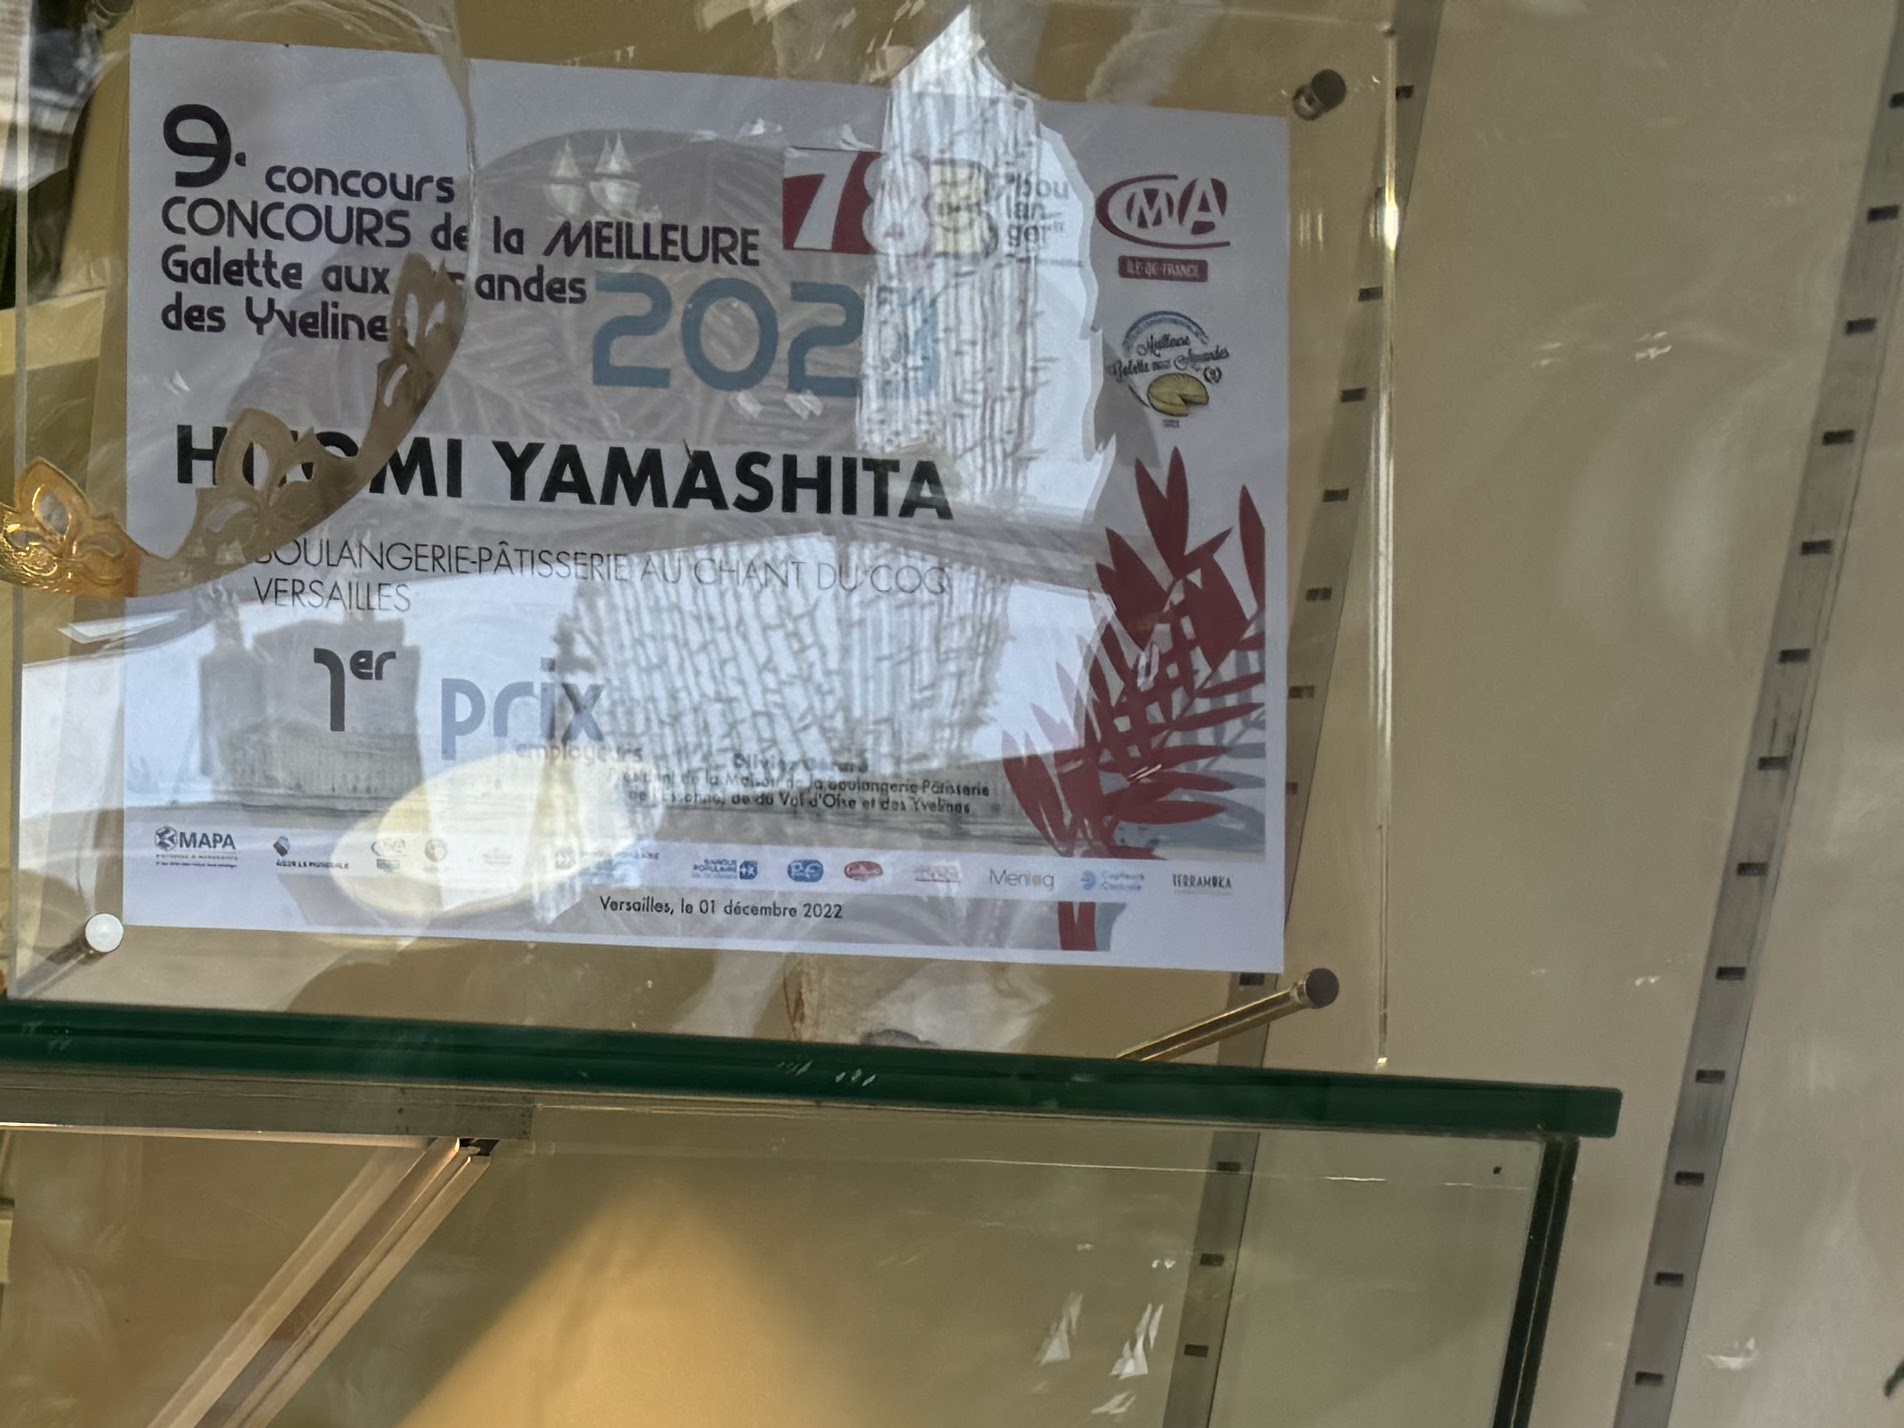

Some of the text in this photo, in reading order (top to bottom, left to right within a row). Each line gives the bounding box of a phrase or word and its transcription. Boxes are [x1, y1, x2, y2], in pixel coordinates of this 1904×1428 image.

[264, 165, 456, 203] concours
[161, 195, 761, 267] CONCOURS de la MEILLEURE
[161, 243, 303, 289] Galette
[321, 263, 391, 295] aux
[161, 291, 390, 342] des Yveline
[491, 439, 954, 520] YAMASHITA
[253, 576, 412, 612] VERSAILLES
[640, 558, 682, 585] AU
[693, 557, 805, 591] CHANT
[817, 561, 860, 593] DU
[870, 563, 952, 595] COQ
[441, 656, 606, 761] prix
[178, 831, 236, 850] MAPA
[599, 896, 844, 920] Versailles, le 01 décembre 2022
